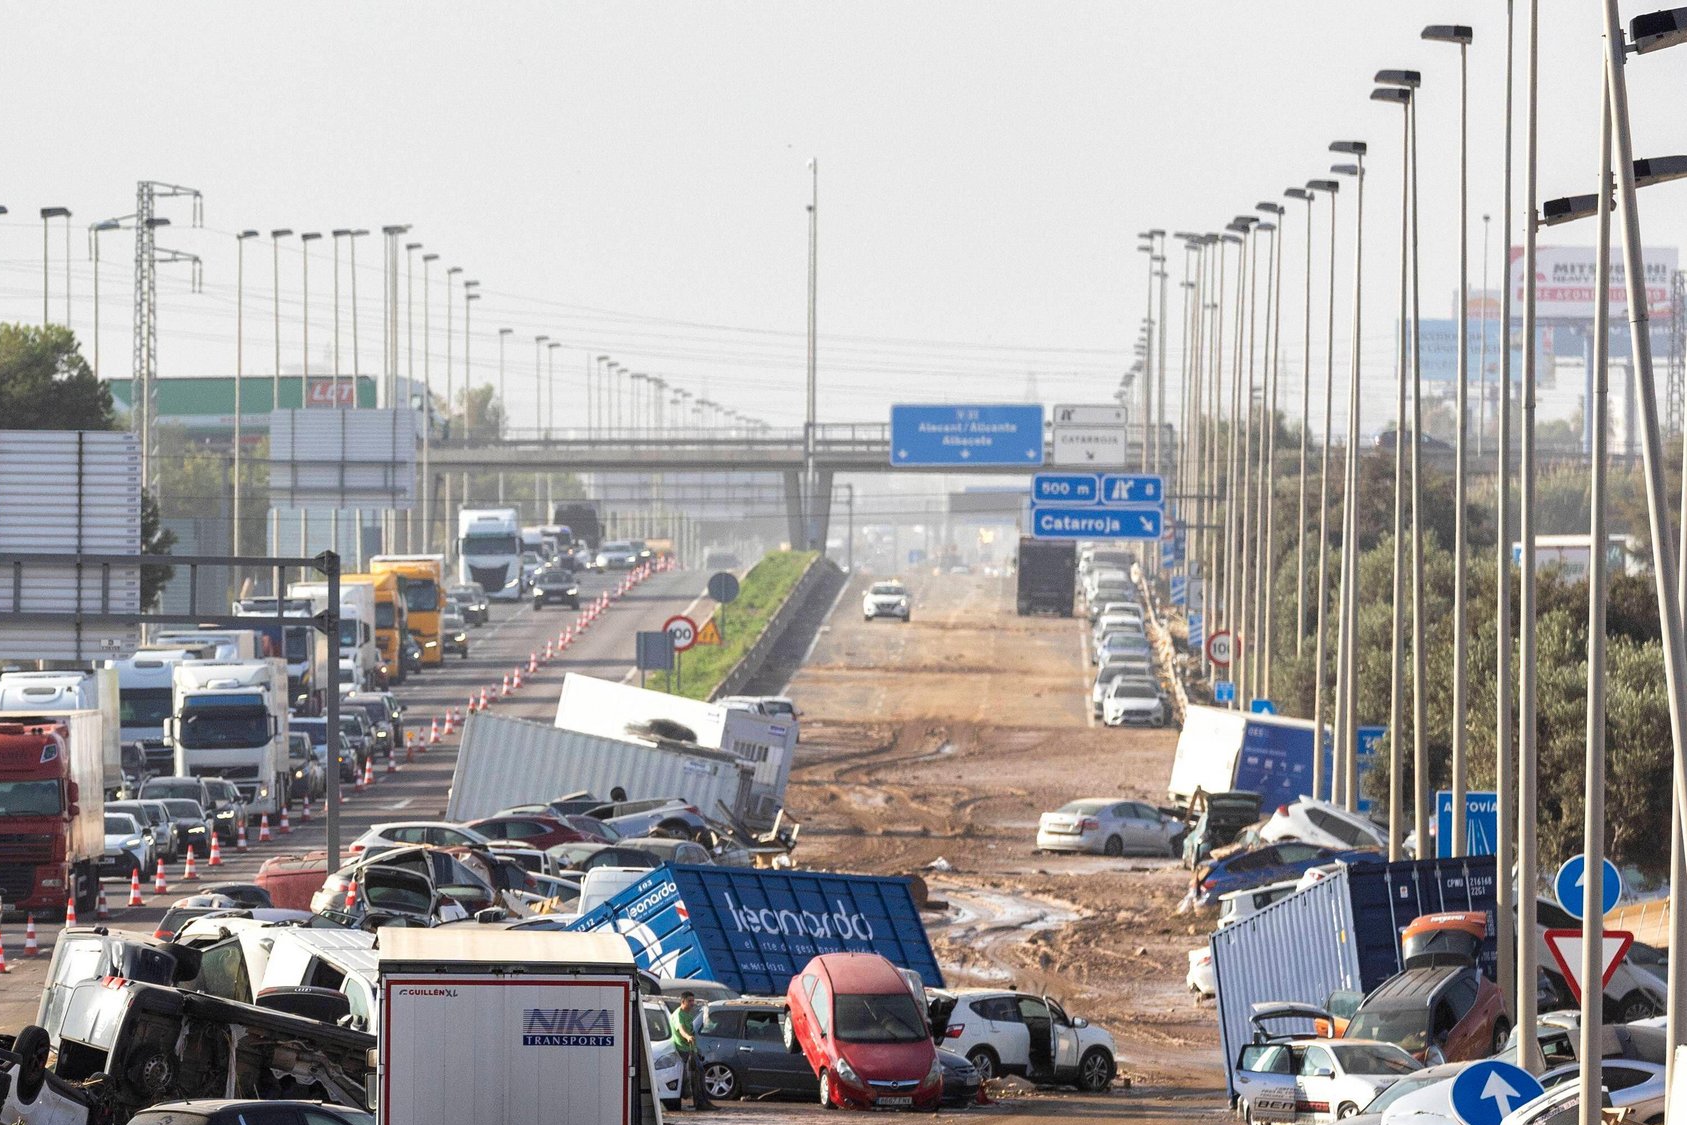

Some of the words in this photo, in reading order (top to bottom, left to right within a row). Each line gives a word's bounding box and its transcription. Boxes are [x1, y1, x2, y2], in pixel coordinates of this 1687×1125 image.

[1042, 482, 1070, 495] 500
[1077, 485, 1090, 495] m
[1041, 514, 1120, 534] Catarroja
[526, 1008, 612, 1034] NIKA
[526, 1036, 612, 1046] TRANSPORTS
